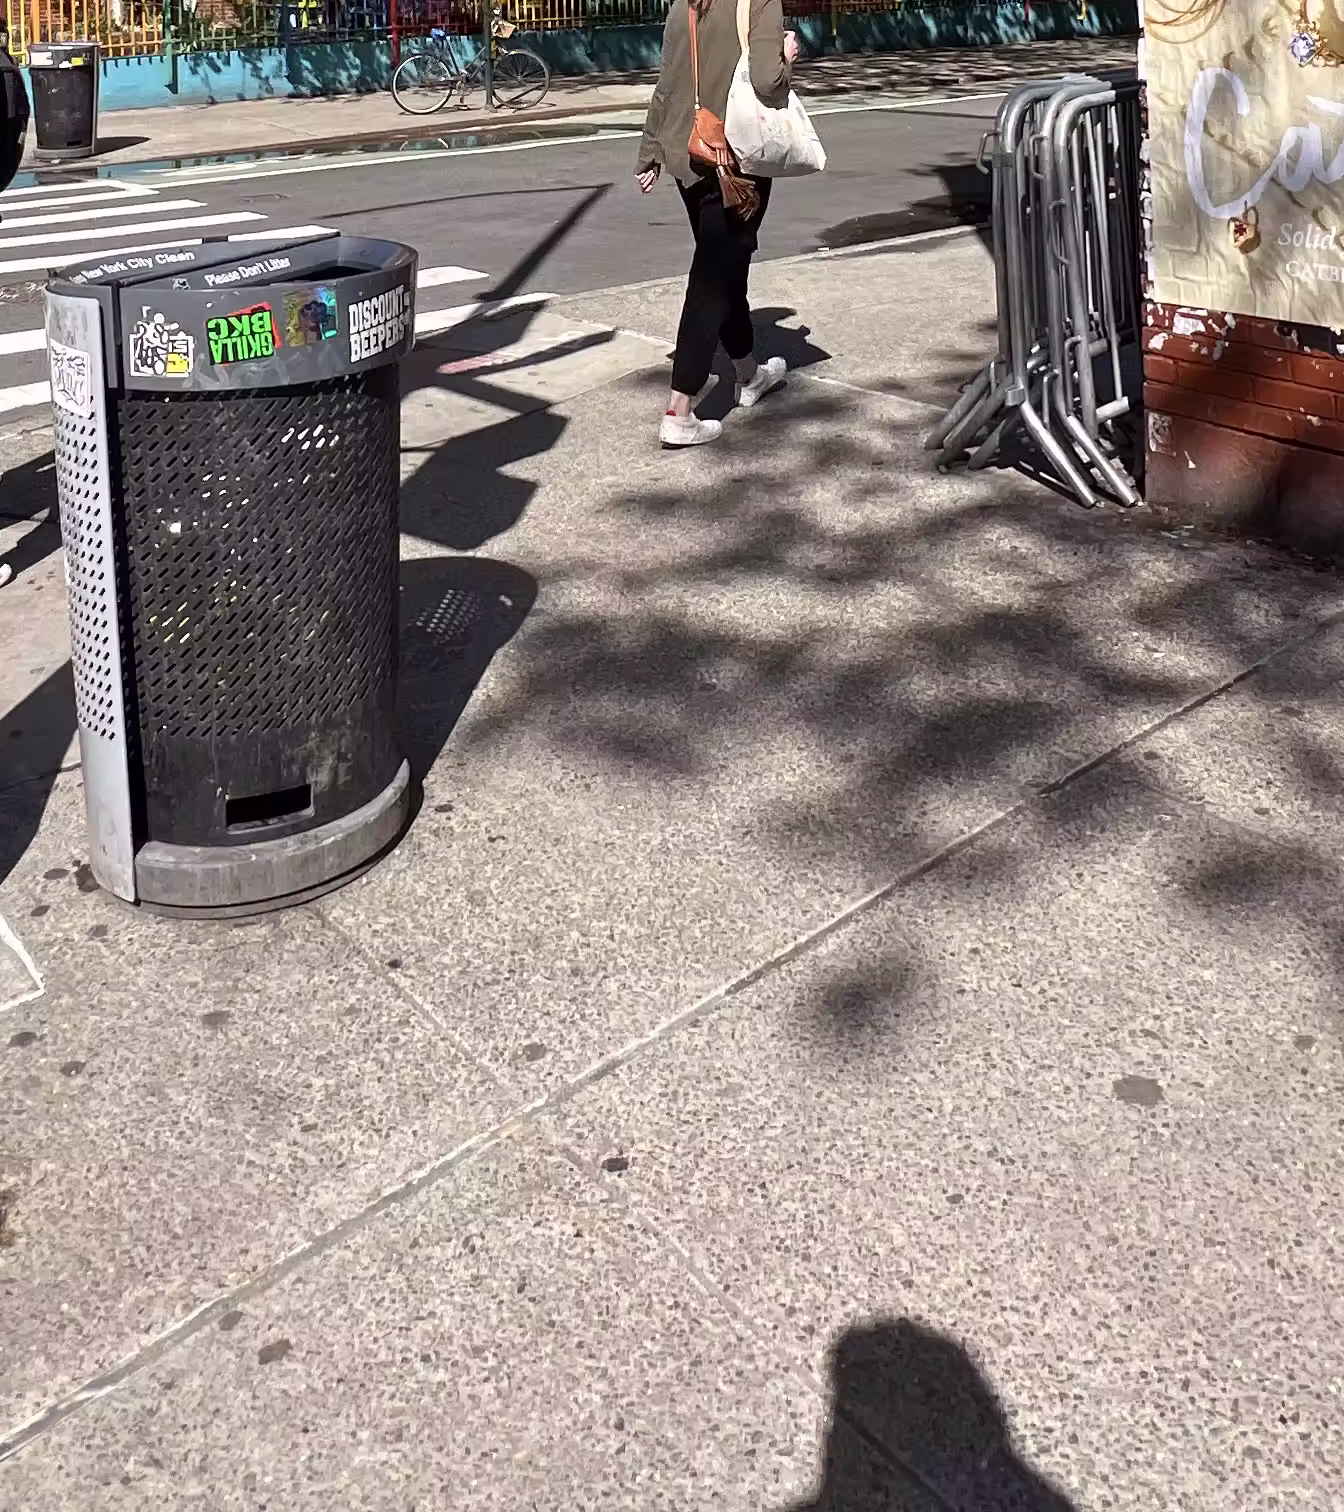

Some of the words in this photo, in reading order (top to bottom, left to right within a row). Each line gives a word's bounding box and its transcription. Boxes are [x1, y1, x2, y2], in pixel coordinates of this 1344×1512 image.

[1277, 222, 1338, 251] Solid
[101, 261, 129, 277] York
[126, 255, 154, 271] City
[154, 250, 197, 266] Clean
[204, 269, 241, 287] Please
[238, 262, 268, 279] Don't
[264, 255, 292, 272] Litter
[207, 310, 273, 340] BKC
[347, 284, 406, 335] DISCOUNT
[209, 329, 275, 365] GKILLA
[349, 312, 406, 364] BEEPERS
